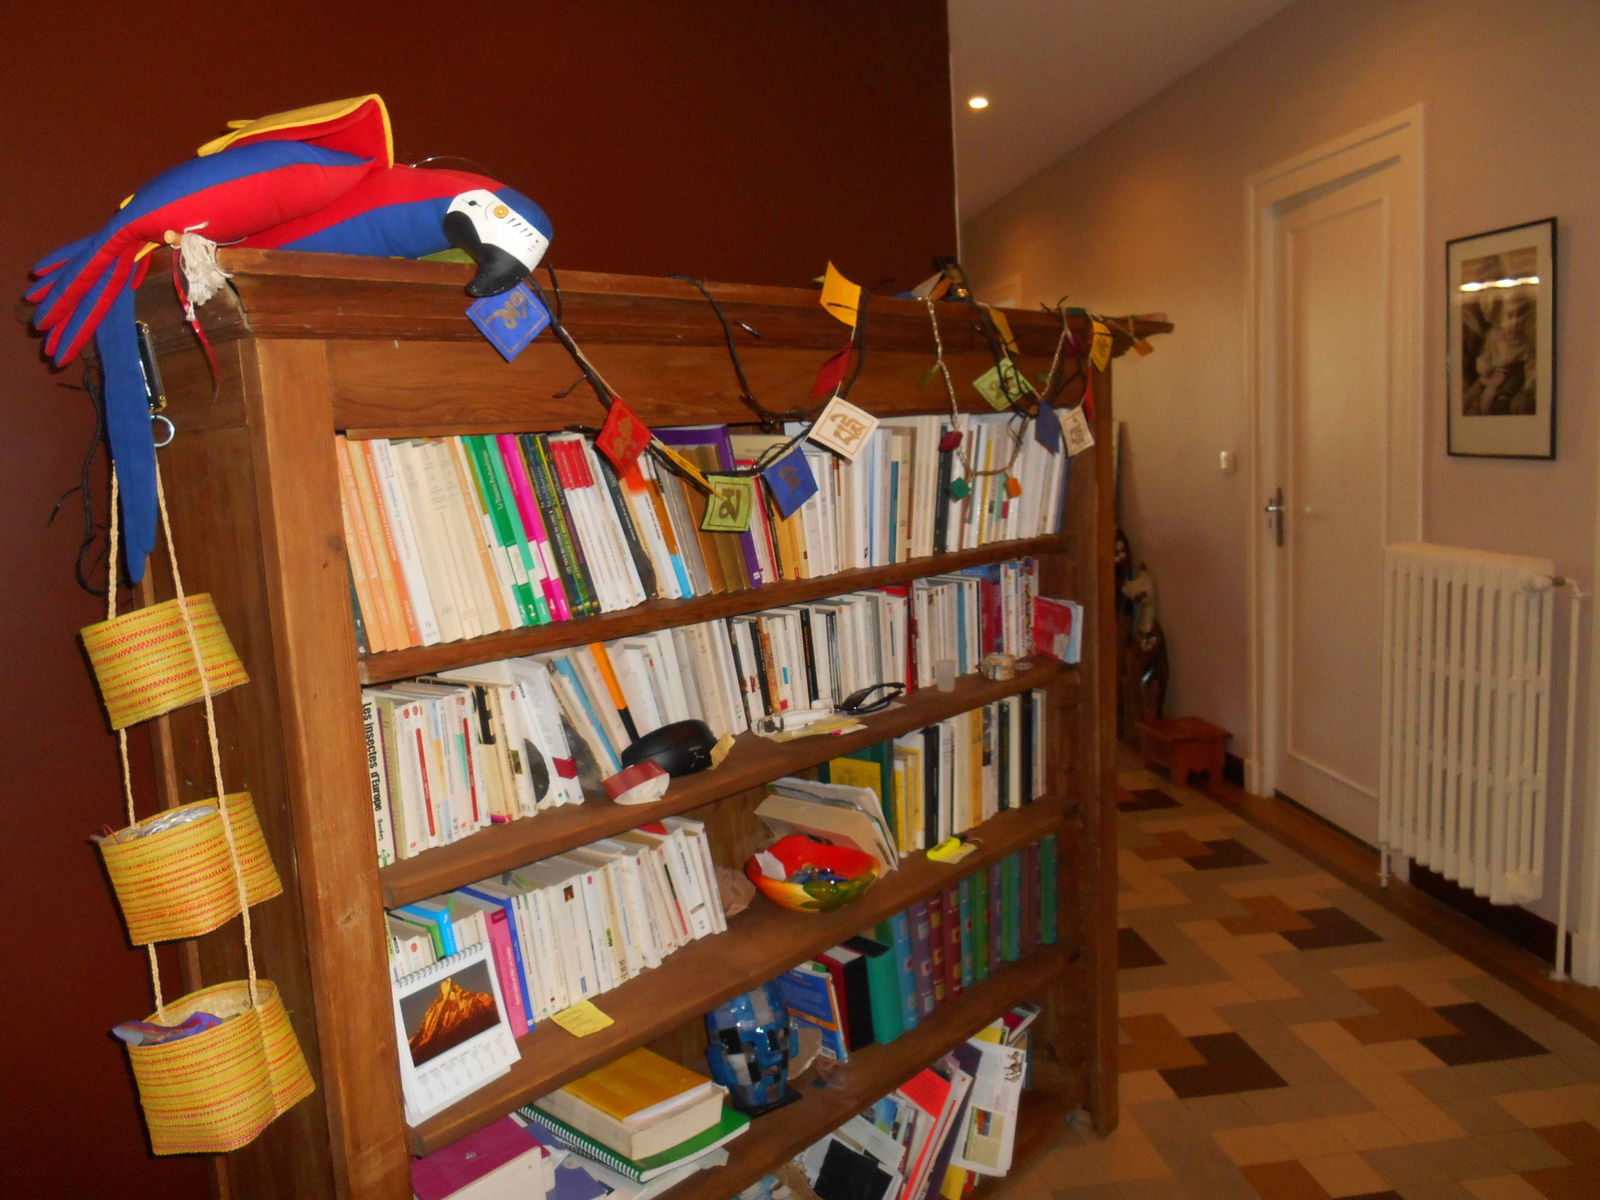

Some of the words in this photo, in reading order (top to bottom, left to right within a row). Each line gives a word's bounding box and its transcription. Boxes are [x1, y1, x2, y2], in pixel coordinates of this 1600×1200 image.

[363, 702, 372, 721] Les
[365, 722, 377, 769] insectes
[371, 771, 382, 812] d'Europe
